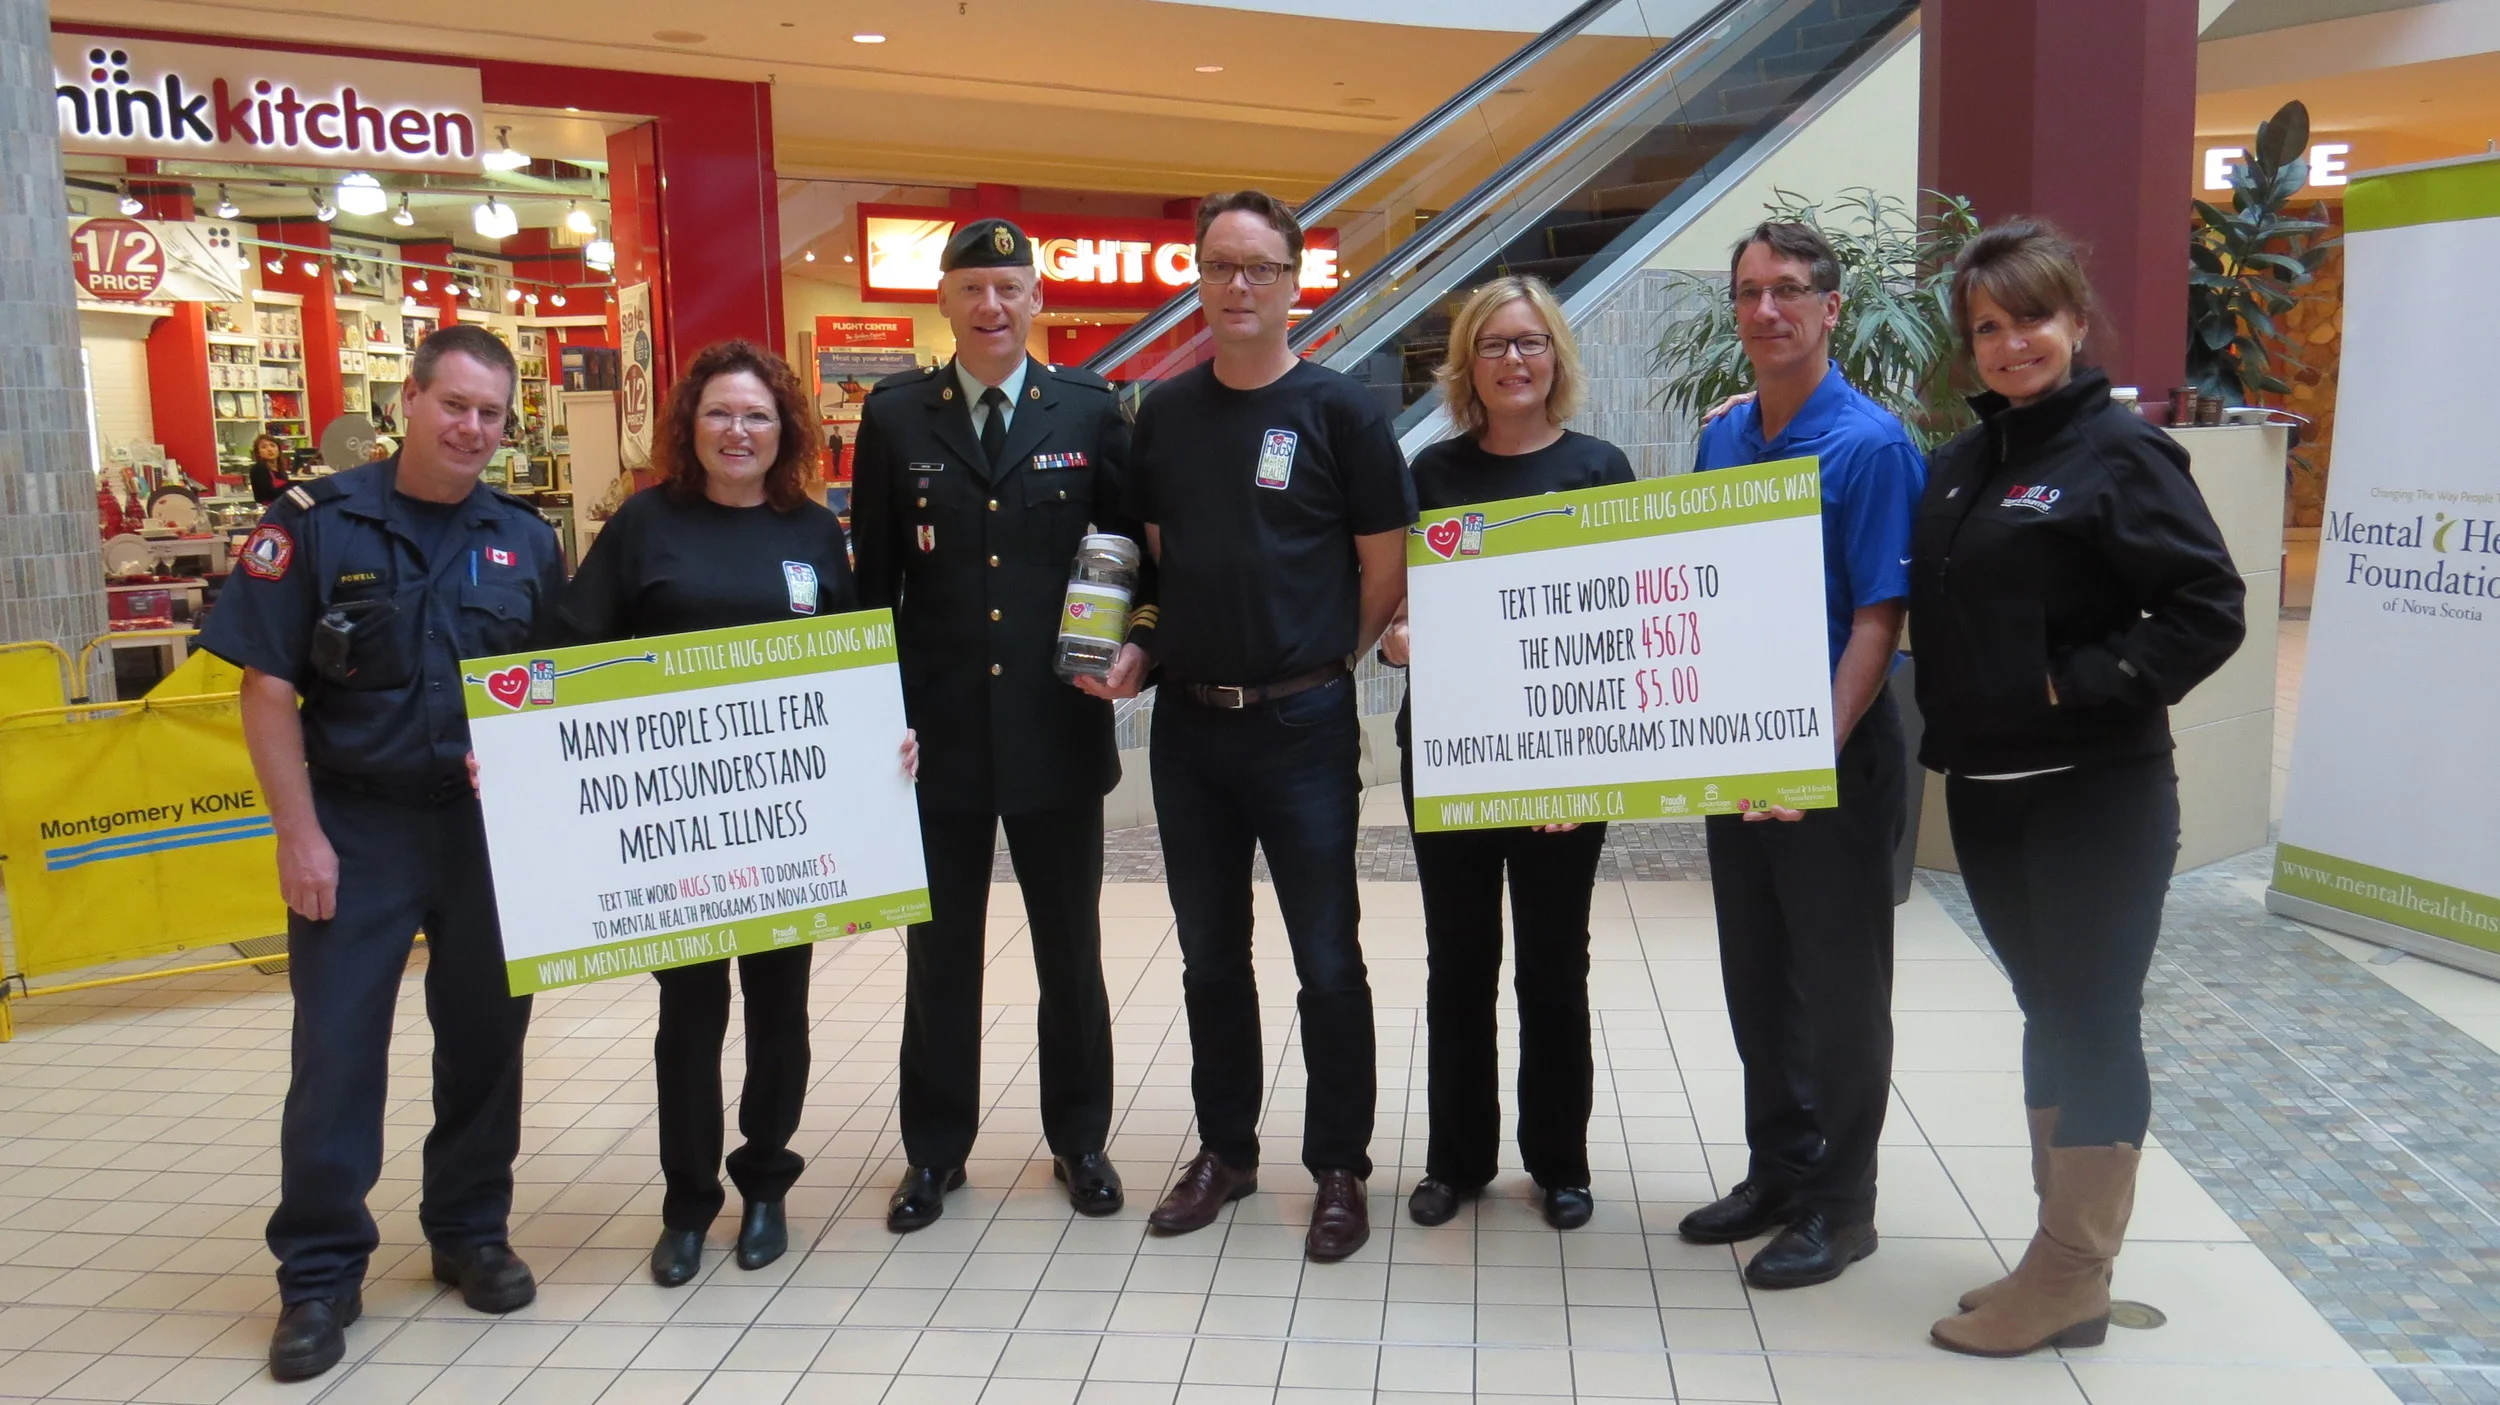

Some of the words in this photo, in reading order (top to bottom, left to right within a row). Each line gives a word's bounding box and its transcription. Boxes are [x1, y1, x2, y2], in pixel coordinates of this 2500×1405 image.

[76, 230, 158, 273] 1/2
[621, 304, 645, 334] sale
[832, 322, 863, 331] FLIGHT
[864, 323, 898, 331] CENTRE
[832, 354, 850, 362] Heat
[851, 355, 861, 363] up
[862, 355, 878, 363] your
[624, 377, 646, 413] 1/2
[1580, 504, 1590, 528] A
[1594, 497, 1640, 527] LITTLE
[1644, 491, 1676, 520] HUG
[1680, 486, 1717, 515] GOES
[1722, 484, 1732, 509] A
[1736, 477, 1780, 507] LONG
[1784, 472, 1816, 501] WAY
[2371, 487, 2414, 502] Changing
[2416, 489, 2434, 500] The
[2437, 491, 2459, 505] Way
[2461, 491, 2494, 505] People
[2326, 511, 2424, 549] Mental
[341, 572, 377, 583] POWELL
[1499, 587, 1536, 620] TEXT
[1542, 582, 1572, 615] THE
[1577, 576, 1630, 612] WORD
[1635, 564, 1689, 605] HUGS
[1694, 564, 1719, 598] TO
[2383, 598, 2398, 612] of
[2402, 599, 2437, 617] Nova
[2440, 602, 2483, 622] Scotia
[664, 650, 675, 676] A
[677, 643, 727, 674] LITTLE
[728, 637, 763, 669] HUG
[766, 633, 803, 662] GOES
[807, 632, 817, 658] A
[818, 627, 861, 656] LONG
[862, 622, 894, 650] WAY
[1519, 637, 1550, 670] THE
[1555, 628, 1636, 667] NUMBER
[1641, 611, 1701, 659] 45678
[1524, 685, 1547, 718] TO
[1552, 678, 1627, 716] DONATE
[1635, 666, 1699, 713] $5.00
[559, 717, 631, 762] MANY
[636, 707, 712, 752] PEOPLE
[715, 699, 775, 741] STILL
[778, 691, 829, 733] FEAR
[1424, 738, 1443, 767] TO
[1446, 733, 1514, 767] MENTAL
[1517, 727, 1574, 760] HEALTH
[1578, 720, 1666, 756] PROGRAMS
[1670, 719, 1694, 748] IN
[1700, 712, 1751, 745] NOVA
[1756, 706, 1819, 742] SCOTIA
[580, 774, 628, 815] AND
[634, 745, 827, 808] MISUNDERSTAND
[1752, 800, 1767, 808] LG
[40, 802, 185, 840] Montgomery
[191, 790, 256, 815] KONE
[619, 815, 717, 864] MENTAL
[719, 800, 808, 847] ILLNESS
[1440, 791, 1625, 826] WWW.MENTALHEALTHNS.CA
[598, 891, 622, 912] TEXT
[624, 887, 644, 908] THE
[643, 882, 678, 906] WORD
[679, 874, 711, 899] HUGS
[713, 874, 727, 893] TO
[728, 865, 760, 891] 45678
[760, 866, 775, 885] TO
[777, 858, 819, 883] DONATE
[819, 853, 837, 877] $5
[2280, 859, 2498, 932] www.mentalhealthns
[592, 921, 608, 940] TO
[609, 913, 658, 939] MENTAL
[659, 906, 699, 930] HEALTH
[700, 895, 758, 922] PROGRAMS
[760, 894, 775, 912] IN
[776, 886, 809, 909] NOVA
[811, 879, 848, 903] SCOTIA
[859, 921, 872, 931] LG
[537, 929, 738, 985] WWW.MENTALHEALTHNS.CA
